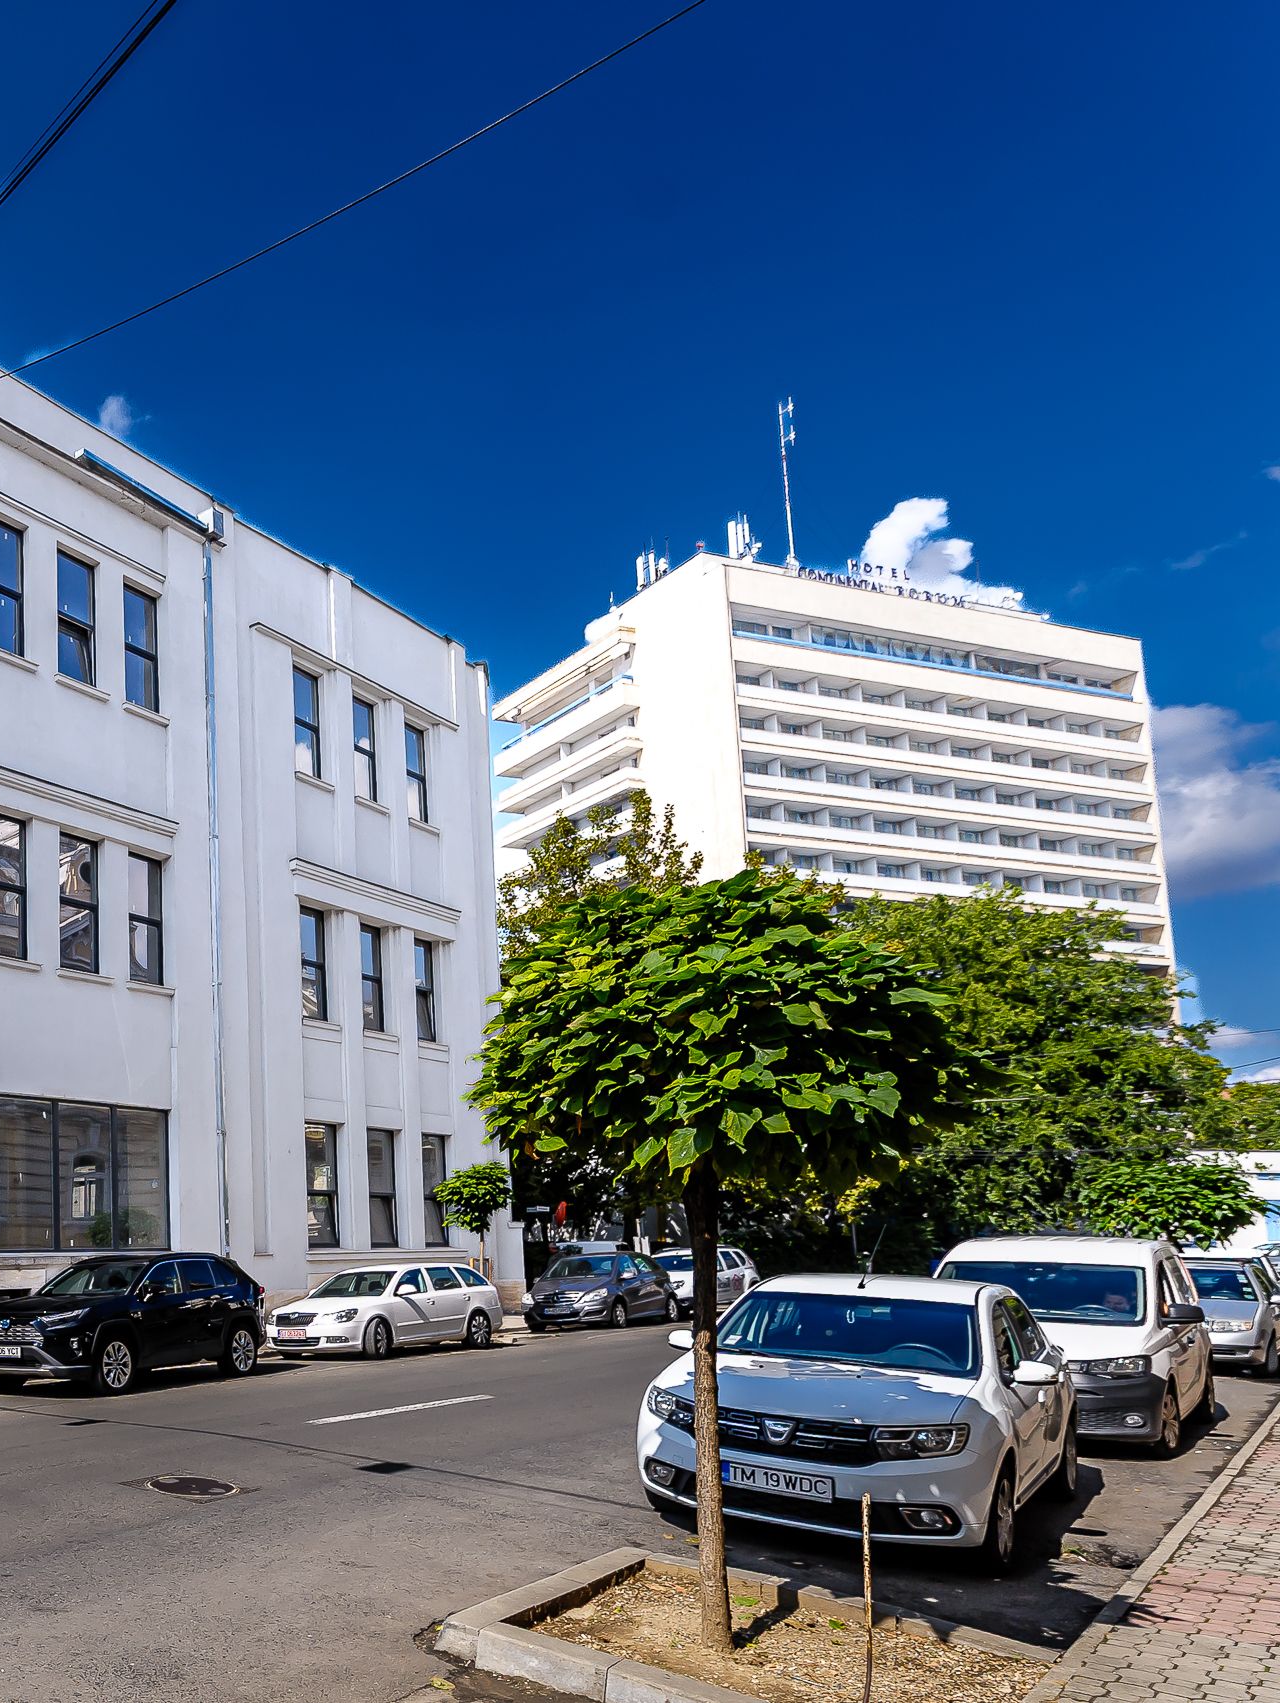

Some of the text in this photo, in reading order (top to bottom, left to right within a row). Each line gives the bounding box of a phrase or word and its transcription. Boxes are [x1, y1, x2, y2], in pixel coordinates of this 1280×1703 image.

[850, 559, 911, 581] HOTEL
[730, 1465, 827, 1495] TM 19 WDC
